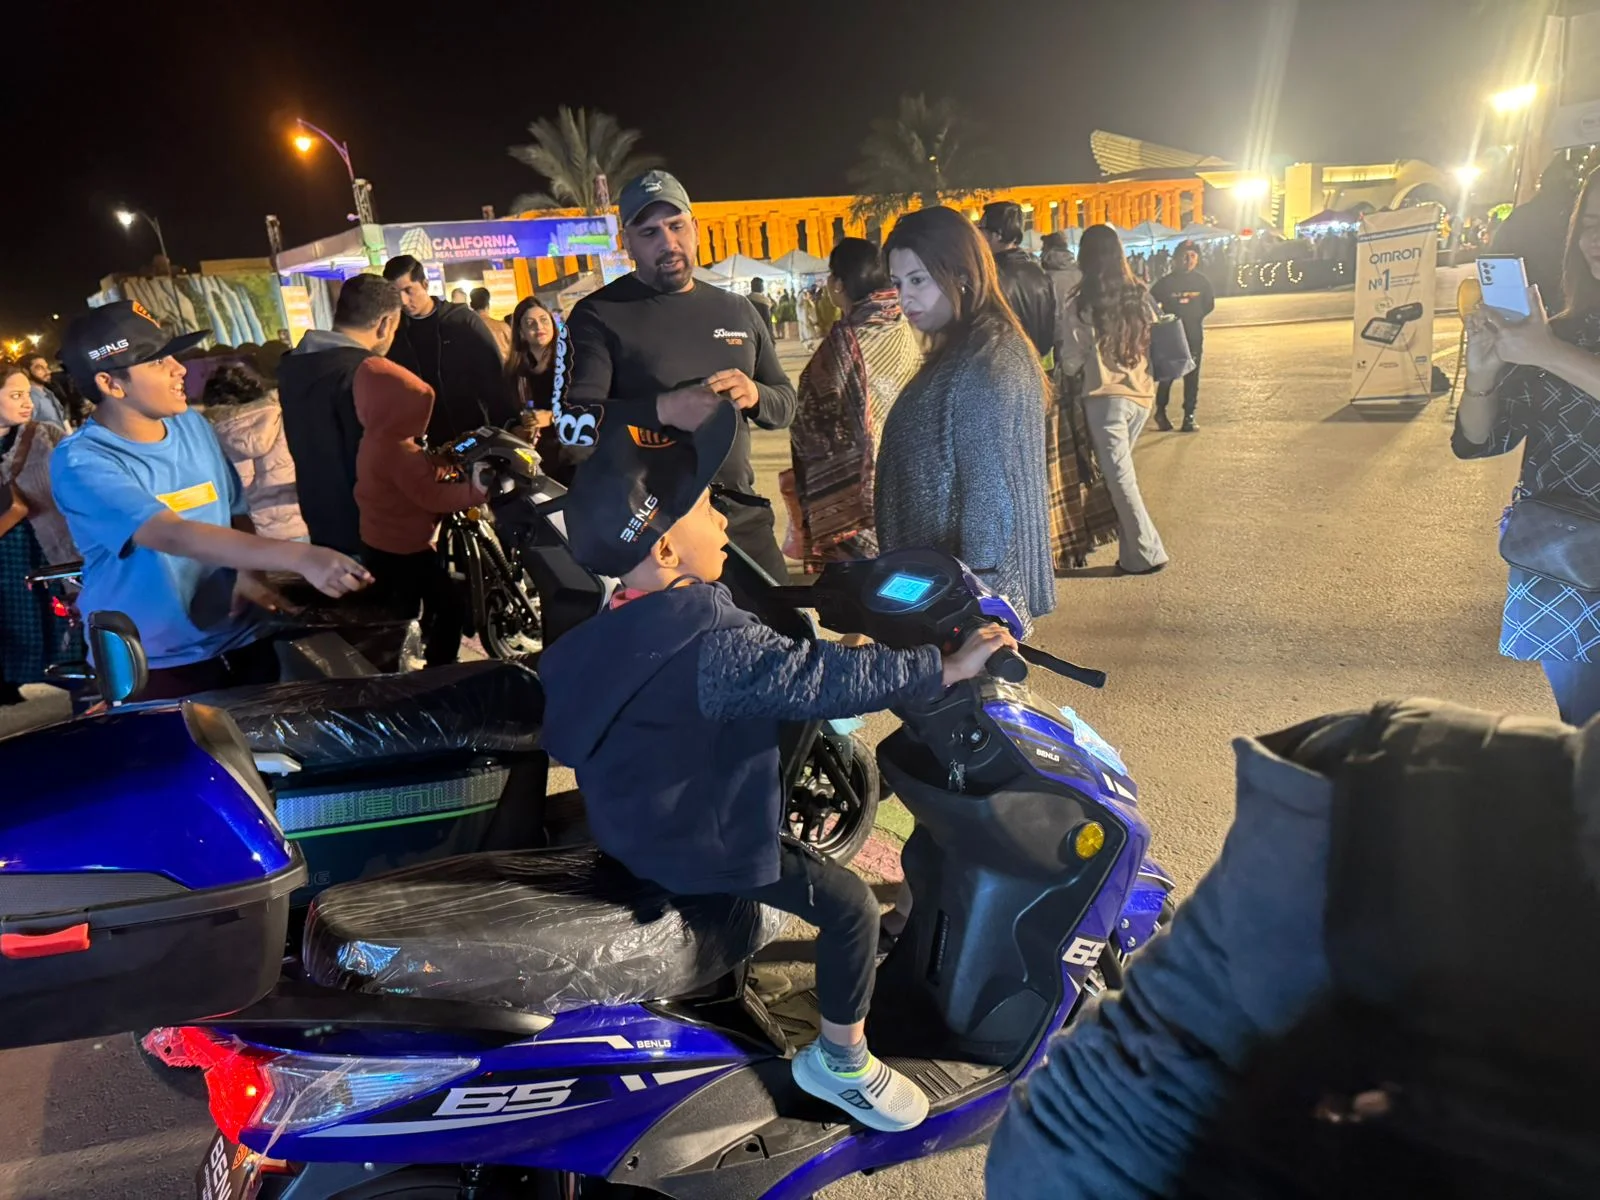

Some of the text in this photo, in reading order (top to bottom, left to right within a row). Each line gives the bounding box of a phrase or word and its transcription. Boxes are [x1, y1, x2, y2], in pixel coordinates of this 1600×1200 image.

[432, 234, 517, 251] CALIFORNIA
[434, 251, 454, 259] REAL
[455, 249, 481, 258] ESTATE
[487, 247, 520, 257] BUILDERS
[88, 338, 129, 360] BENLG
[620, 494, 659, 543] BENLG
[636, 1039, 671, 1049] BENLG
[432, 1077, 580, 1116] 65
